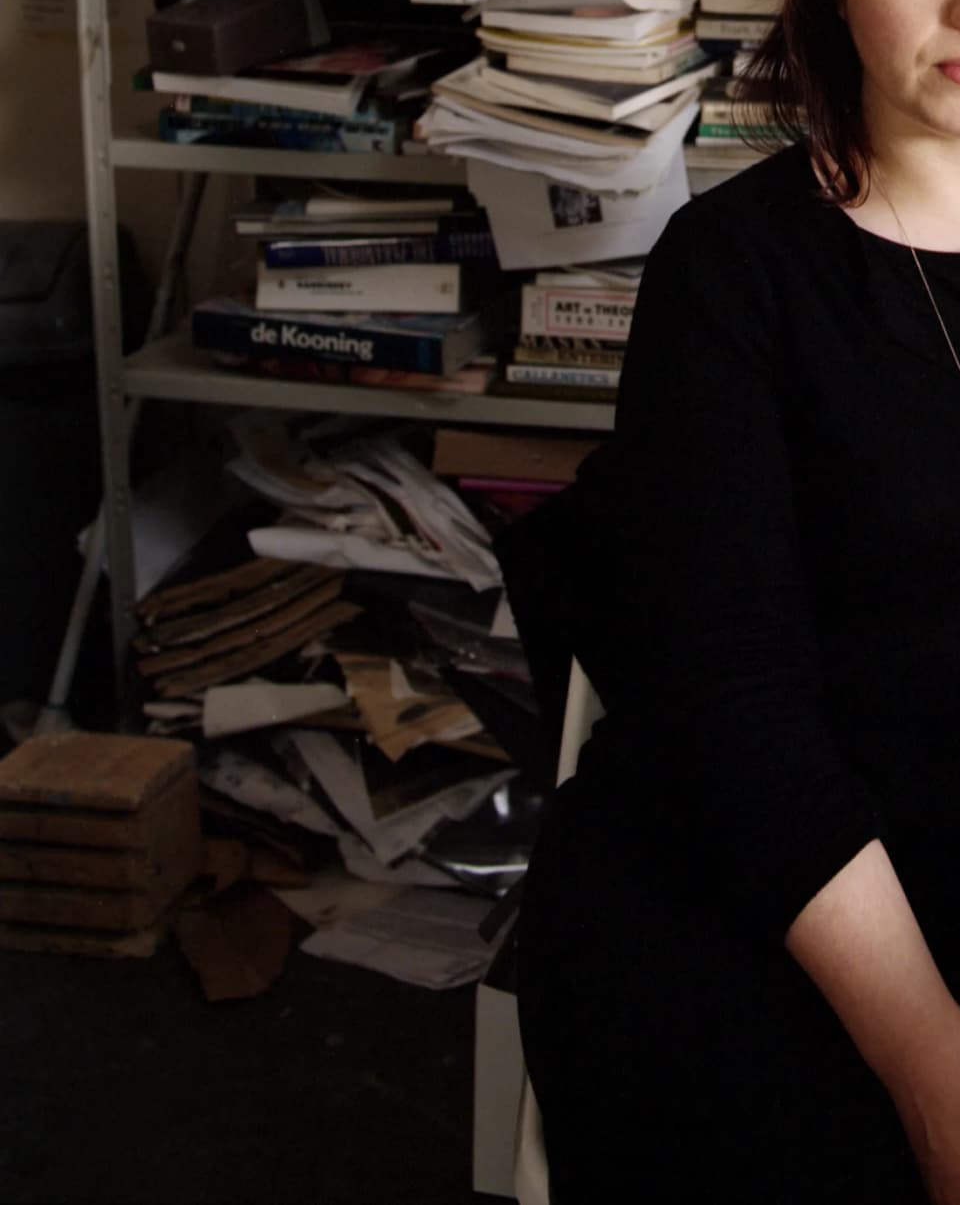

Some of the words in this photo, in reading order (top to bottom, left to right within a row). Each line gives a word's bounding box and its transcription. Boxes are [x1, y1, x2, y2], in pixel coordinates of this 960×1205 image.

[555, 301, 580, 313] ART
[251, 323, 277, 343] de
[281, 326, 375, 362] Kooning
